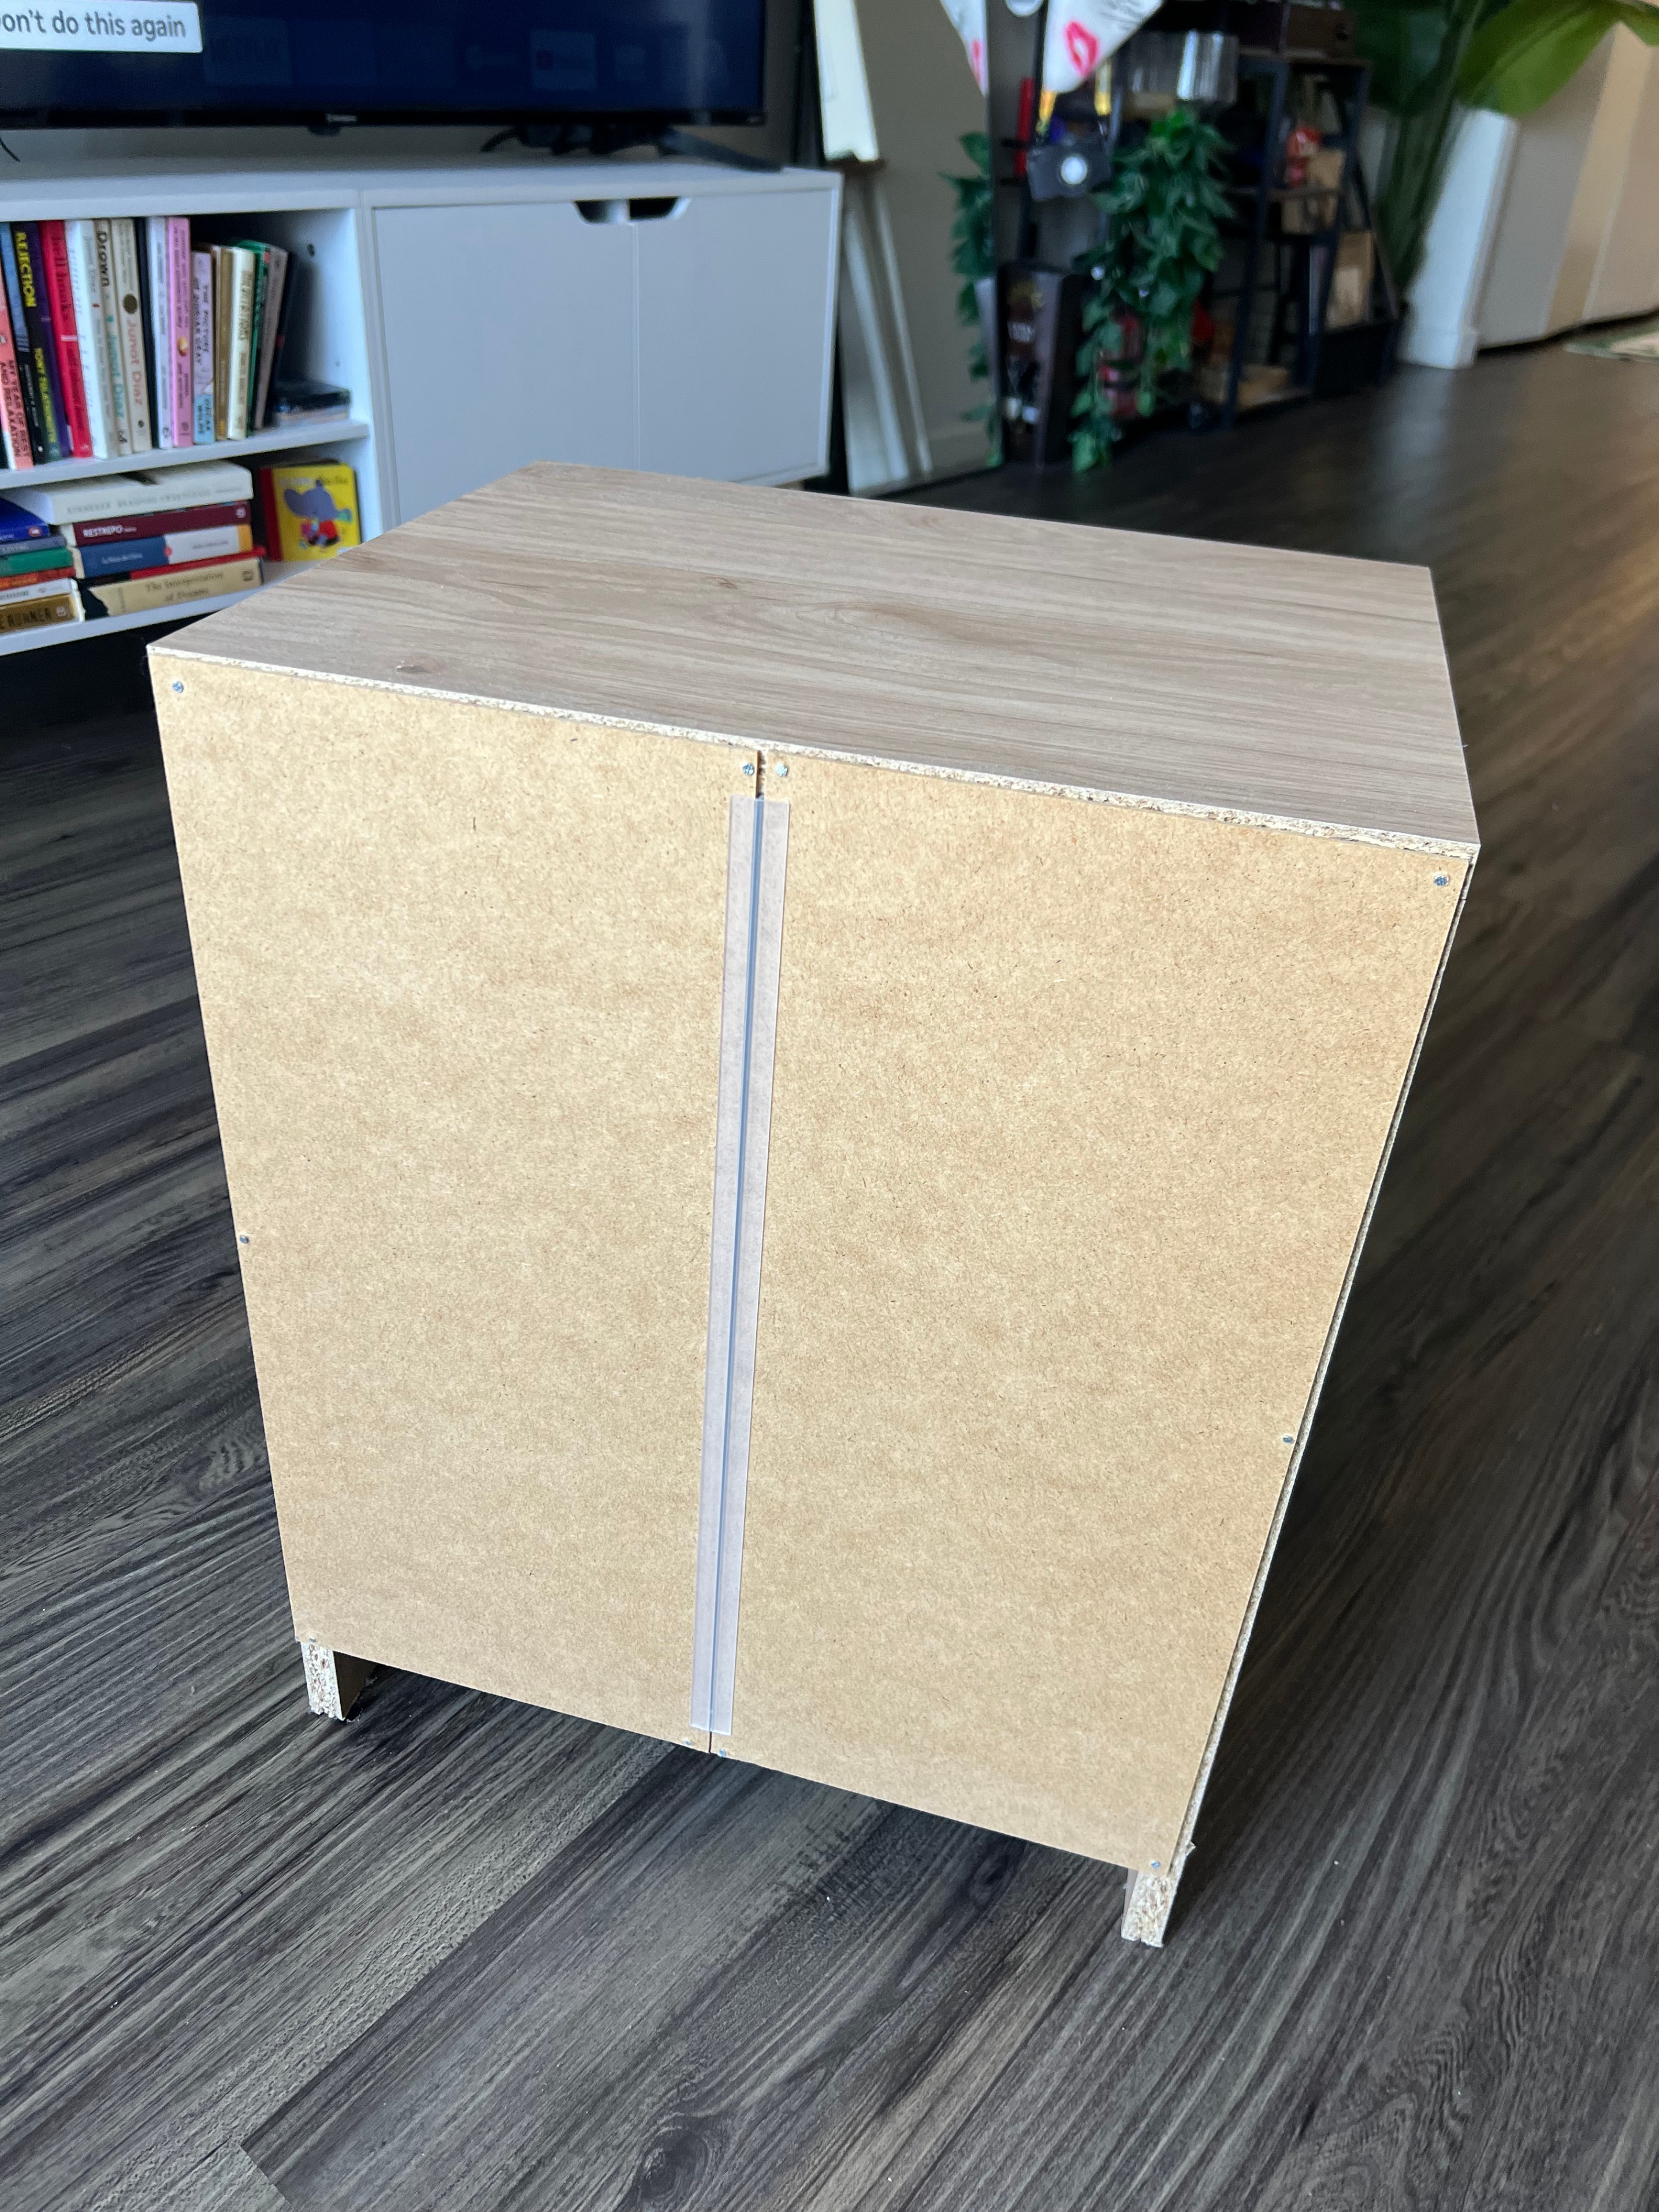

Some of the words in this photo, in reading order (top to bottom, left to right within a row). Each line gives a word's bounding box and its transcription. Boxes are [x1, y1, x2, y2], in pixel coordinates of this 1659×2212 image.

[0, 9, 46, 33] on't
[52, 10, 79, 34] do
[84, 12, 125, 36] this
[131, 15, 187, 42] again
[16, 232, 36, 307] REJECTION
[96, 232, 111, 286] Drown
[0, 362, 9, 385] AND
[8, 360, 16, 377] MY
[11, 379, 21, 409] YEAR
[3, 388, 20, 457] RELAXATION
[17, 412, 24, 426] OF
[20, 430, 29, 457] REST
[83, 524, 124, 538] RESTREPO
